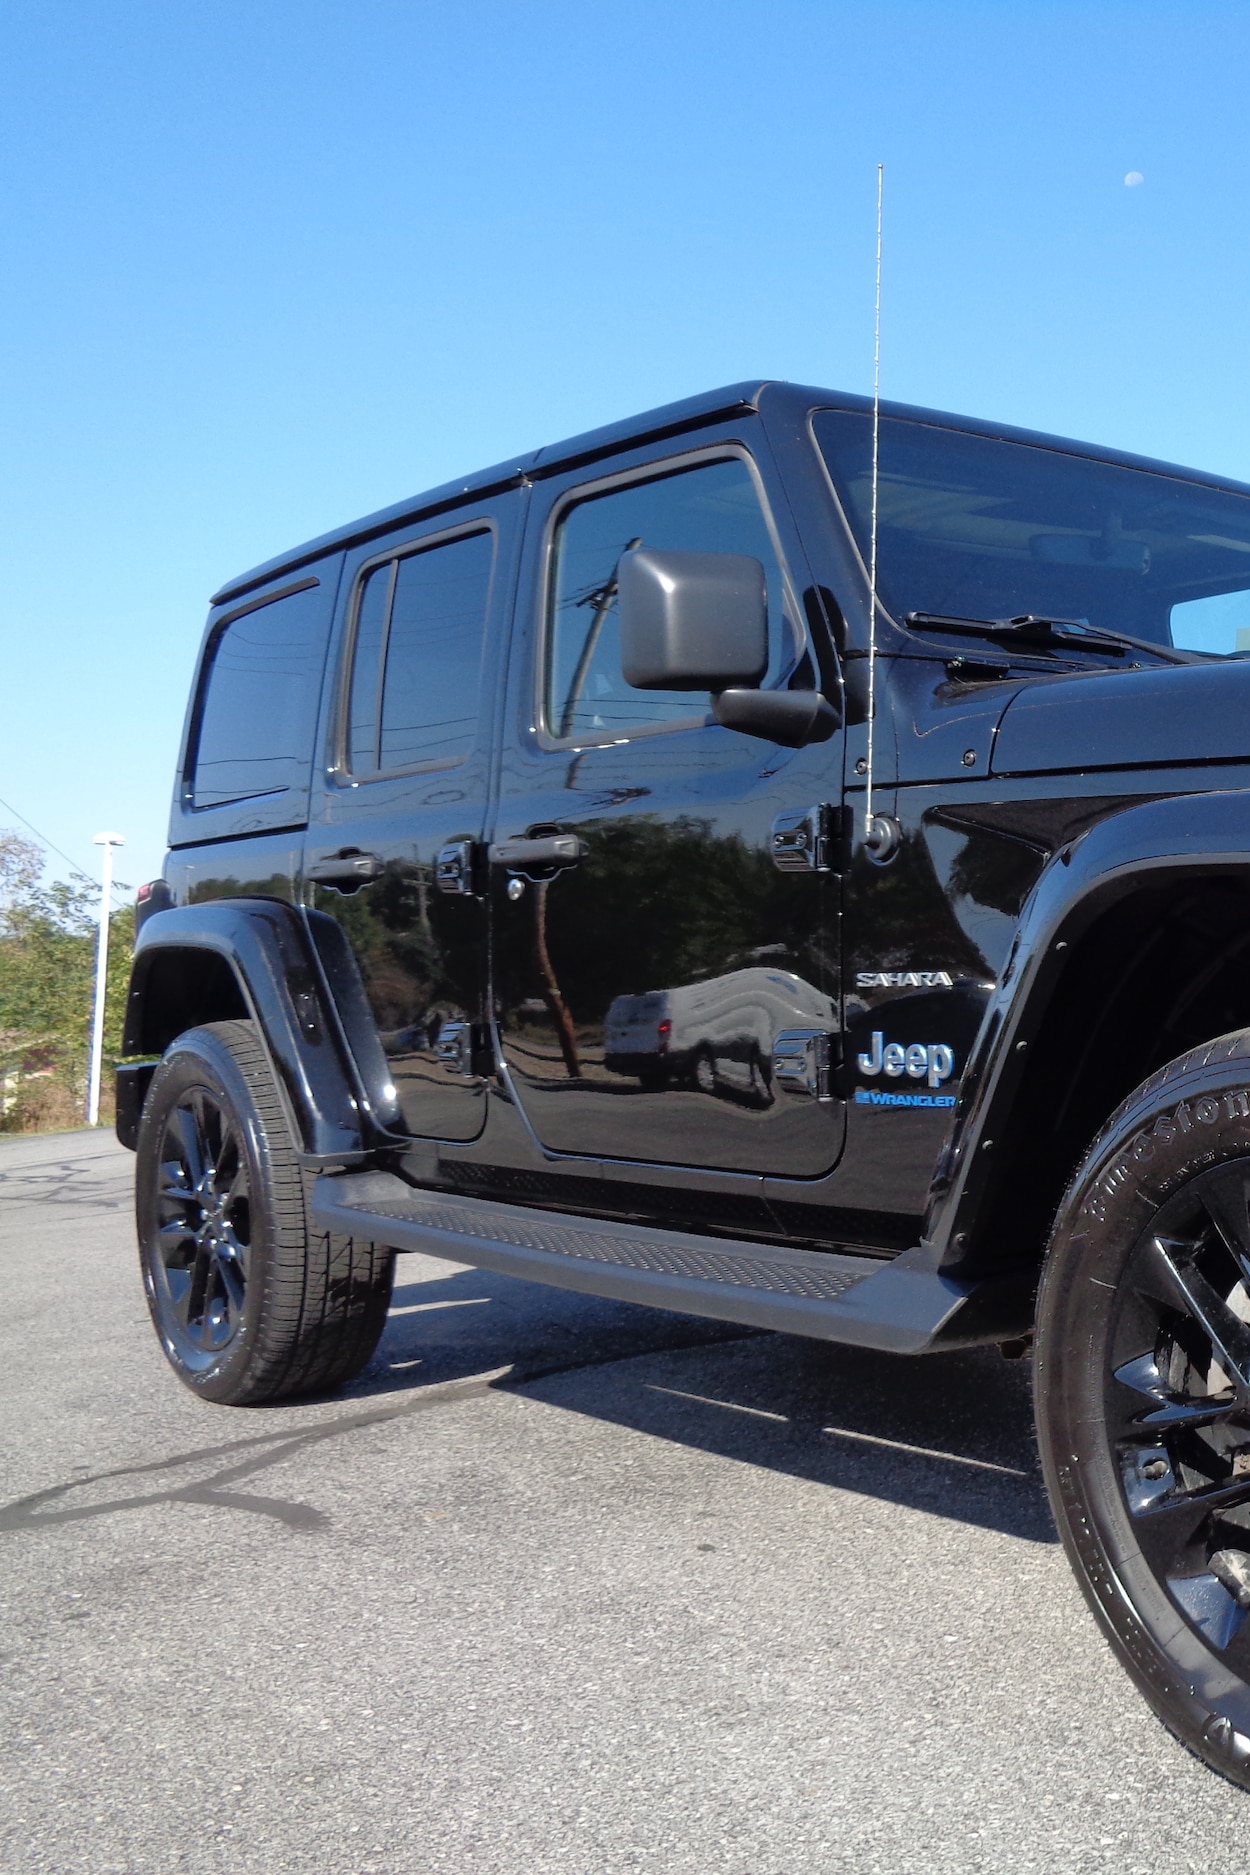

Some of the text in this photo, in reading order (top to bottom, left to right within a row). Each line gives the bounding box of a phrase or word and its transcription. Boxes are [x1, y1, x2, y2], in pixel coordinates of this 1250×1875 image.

[855, 971, 953, 988] SAHARA
[857, 1031, 955, 1088] Jeep
[867, 1092, 957, 1108] WRANGLER
